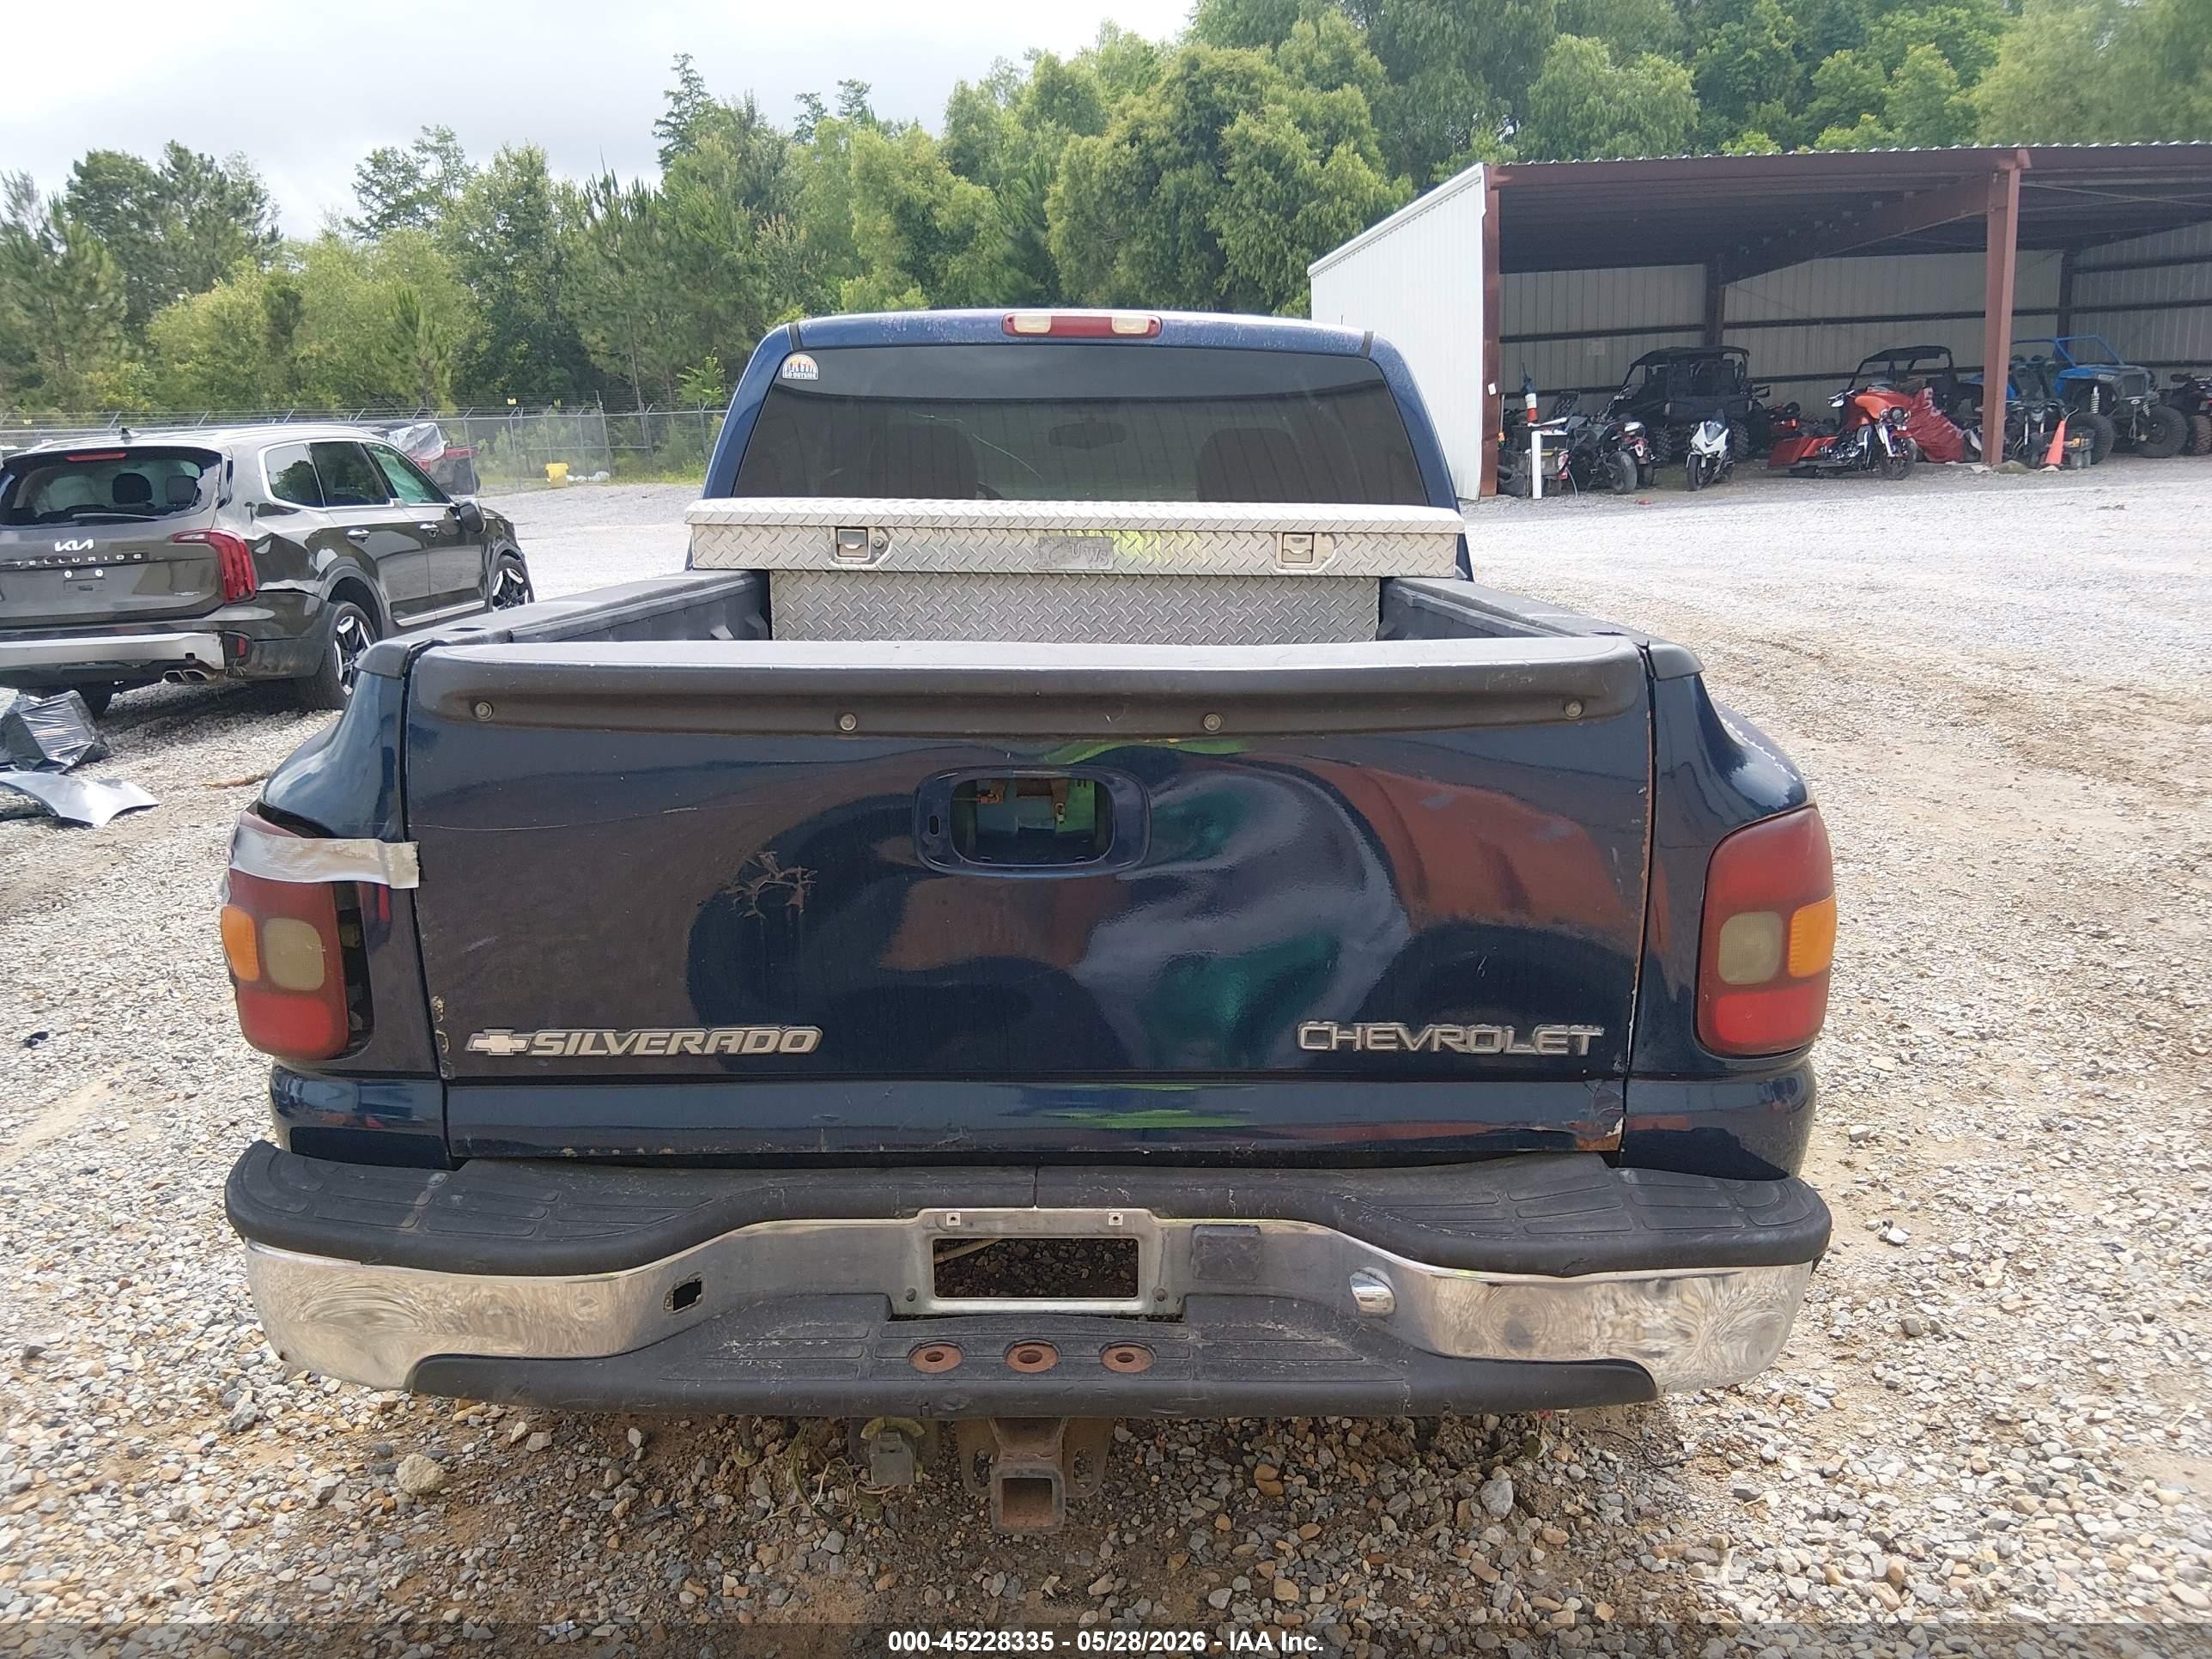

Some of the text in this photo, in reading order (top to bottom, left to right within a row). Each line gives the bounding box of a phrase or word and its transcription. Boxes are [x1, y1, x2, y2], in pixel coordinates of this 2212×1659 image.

[55, 539, 94, 551] KIA
[16, 553, 142, 566] TELLURIDE
[531, 1029, 822, 1056] SILVERADO
[1298, 1022, 1603, 1055] CHEVROLET
